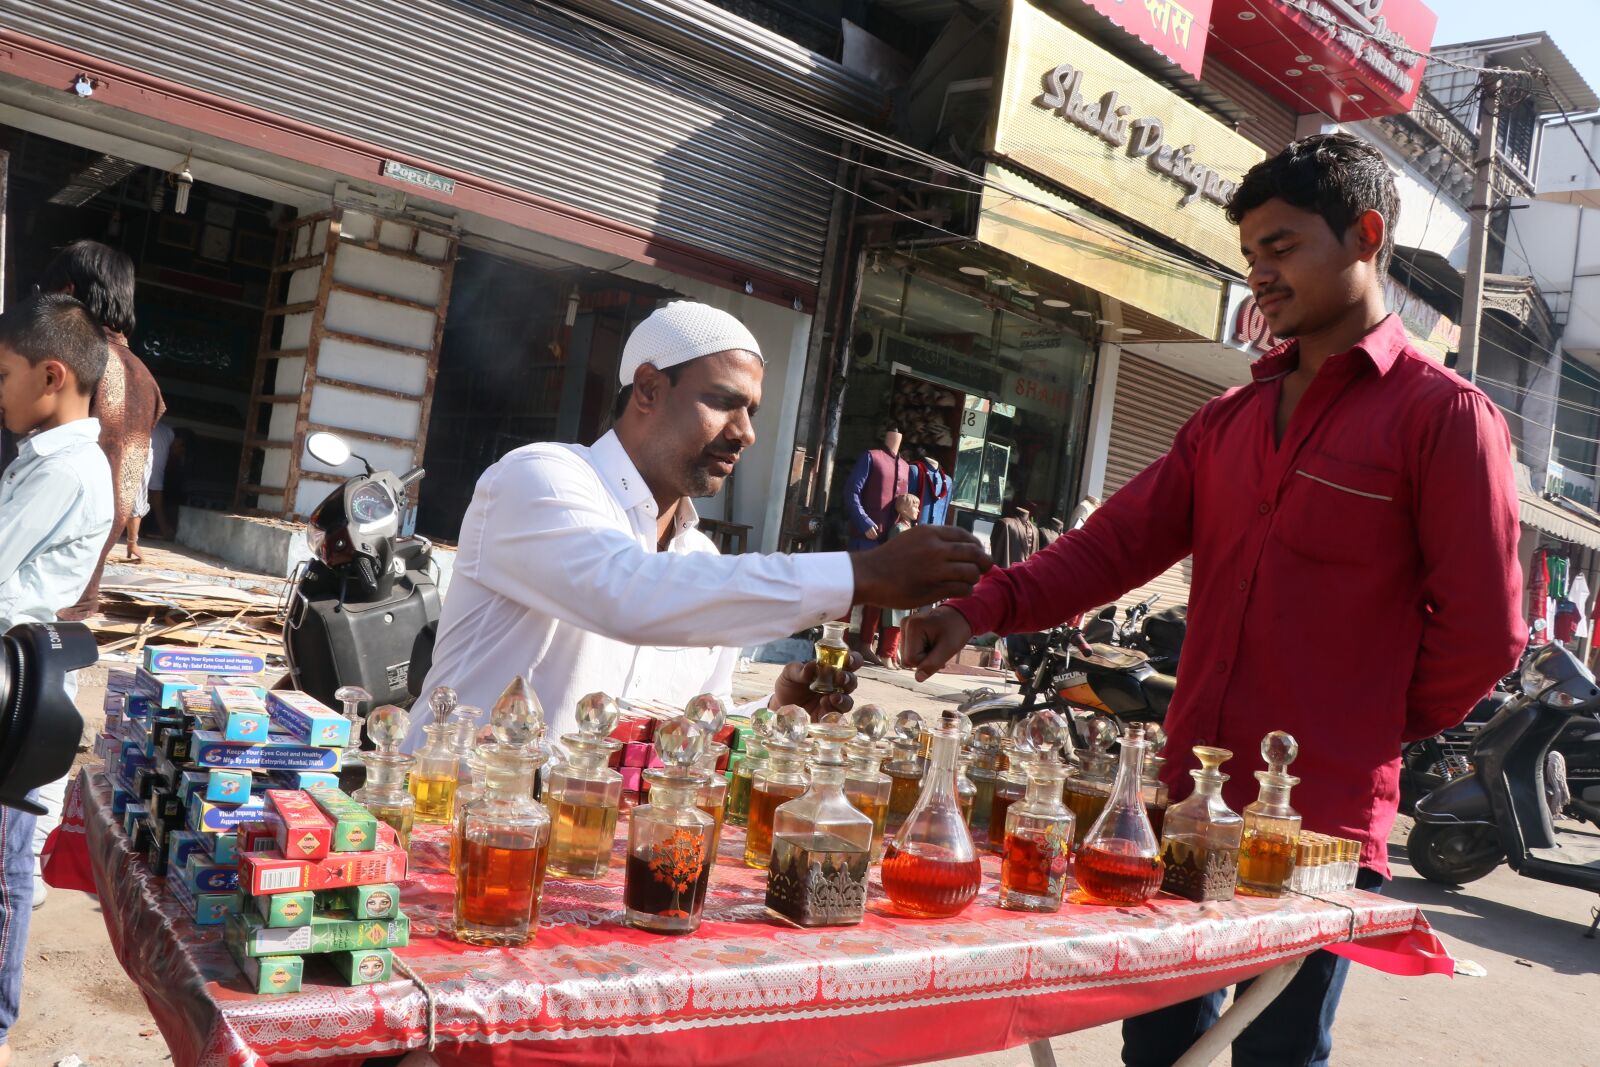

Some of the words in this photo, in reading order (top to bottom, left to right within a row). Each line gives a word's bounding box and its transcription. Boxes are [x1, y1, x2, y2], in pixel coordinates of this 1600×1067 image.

[1040, 63, 1132, 146] Shahi
[1053, 670, 1088, 683] SUZUKI
[226, 748, 245, 756] Keeps
[260, 749, 275, 757] Eyes
[301, 751, 323, 760] Healthy
